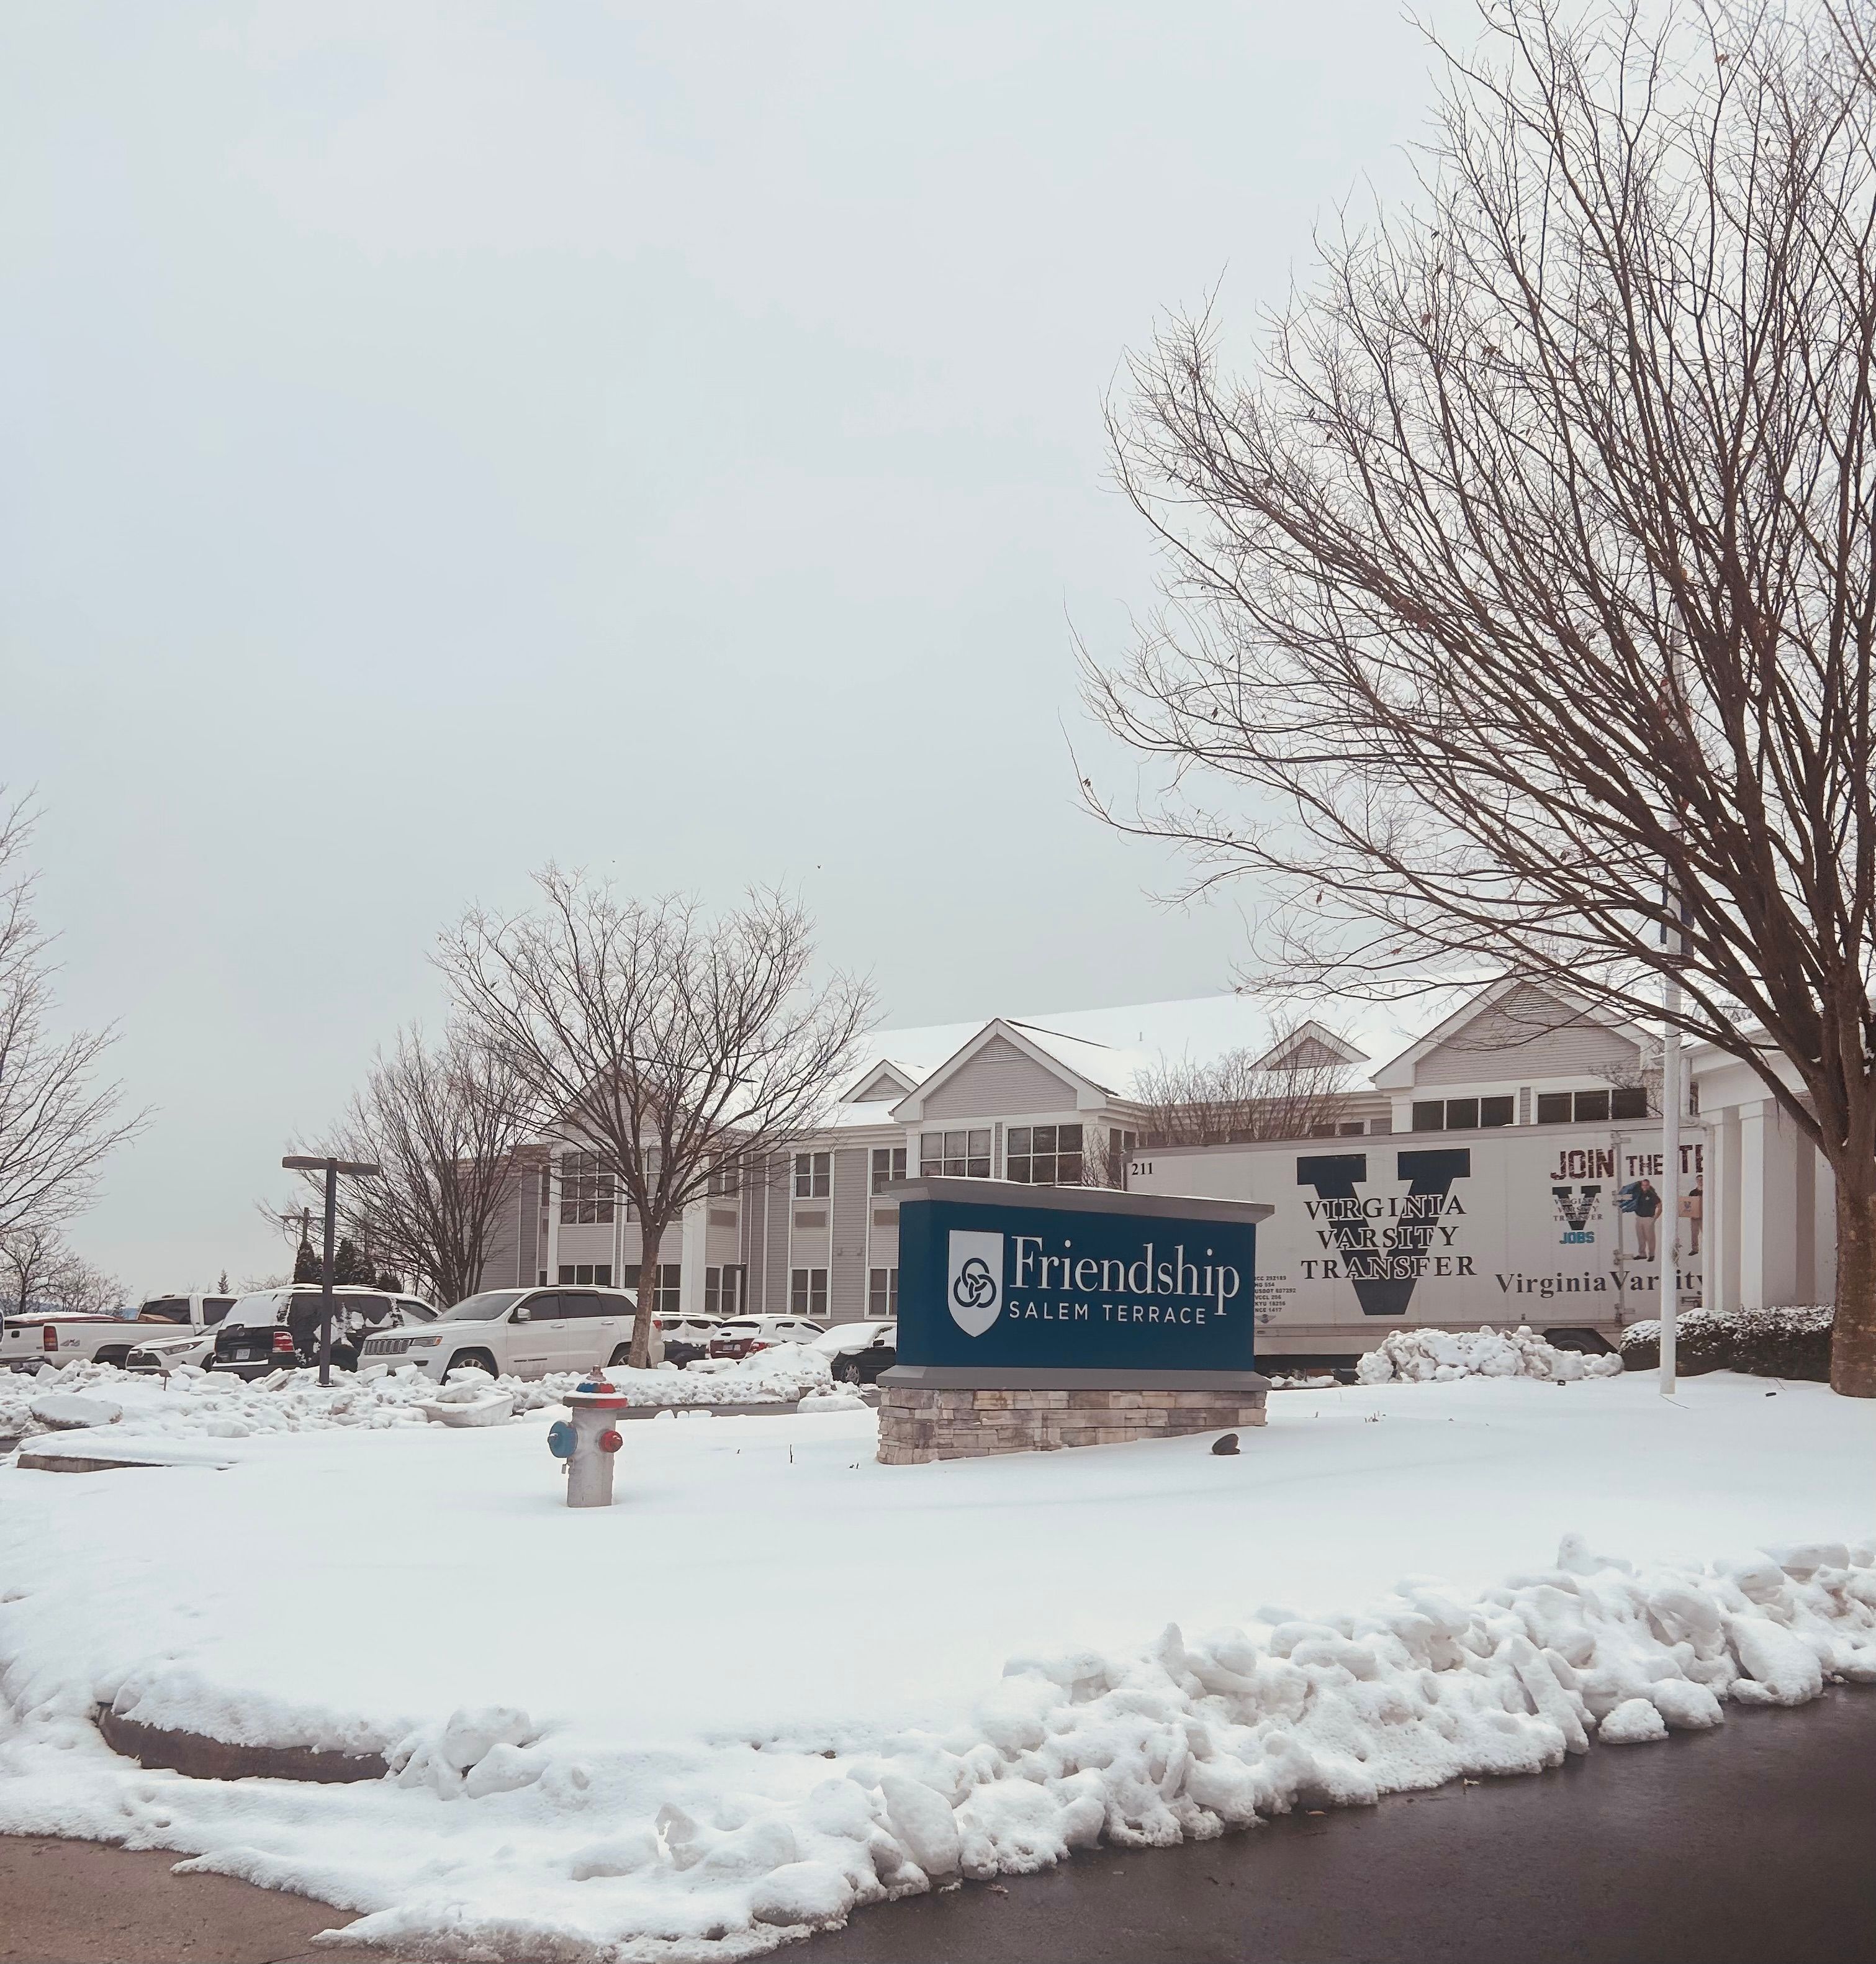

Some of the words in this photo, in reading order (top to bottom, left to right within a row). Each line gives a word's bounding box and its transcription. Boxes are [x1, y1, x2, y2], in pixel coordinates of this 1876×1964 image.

[1132, 1162, 1153, 1175] 211
[1550, 1149, 1615, 1180] JOIN
[1625, 1154, 1664, 1177] THE
[1303, 1195, 1468, 1221] VIRGINIA
[1315, 1225, 1459, 1250] VARSITY
[1559, 1231, 1595, 1244] JOBS
[1009, 1236, 1240, 1316] Friendship
[1301, 1256, 1477, 1280] TRANSFER
[1009, 1301, 1088, 1321] SALEM
[1103, 1305, 1206, 1324] TERRACE
